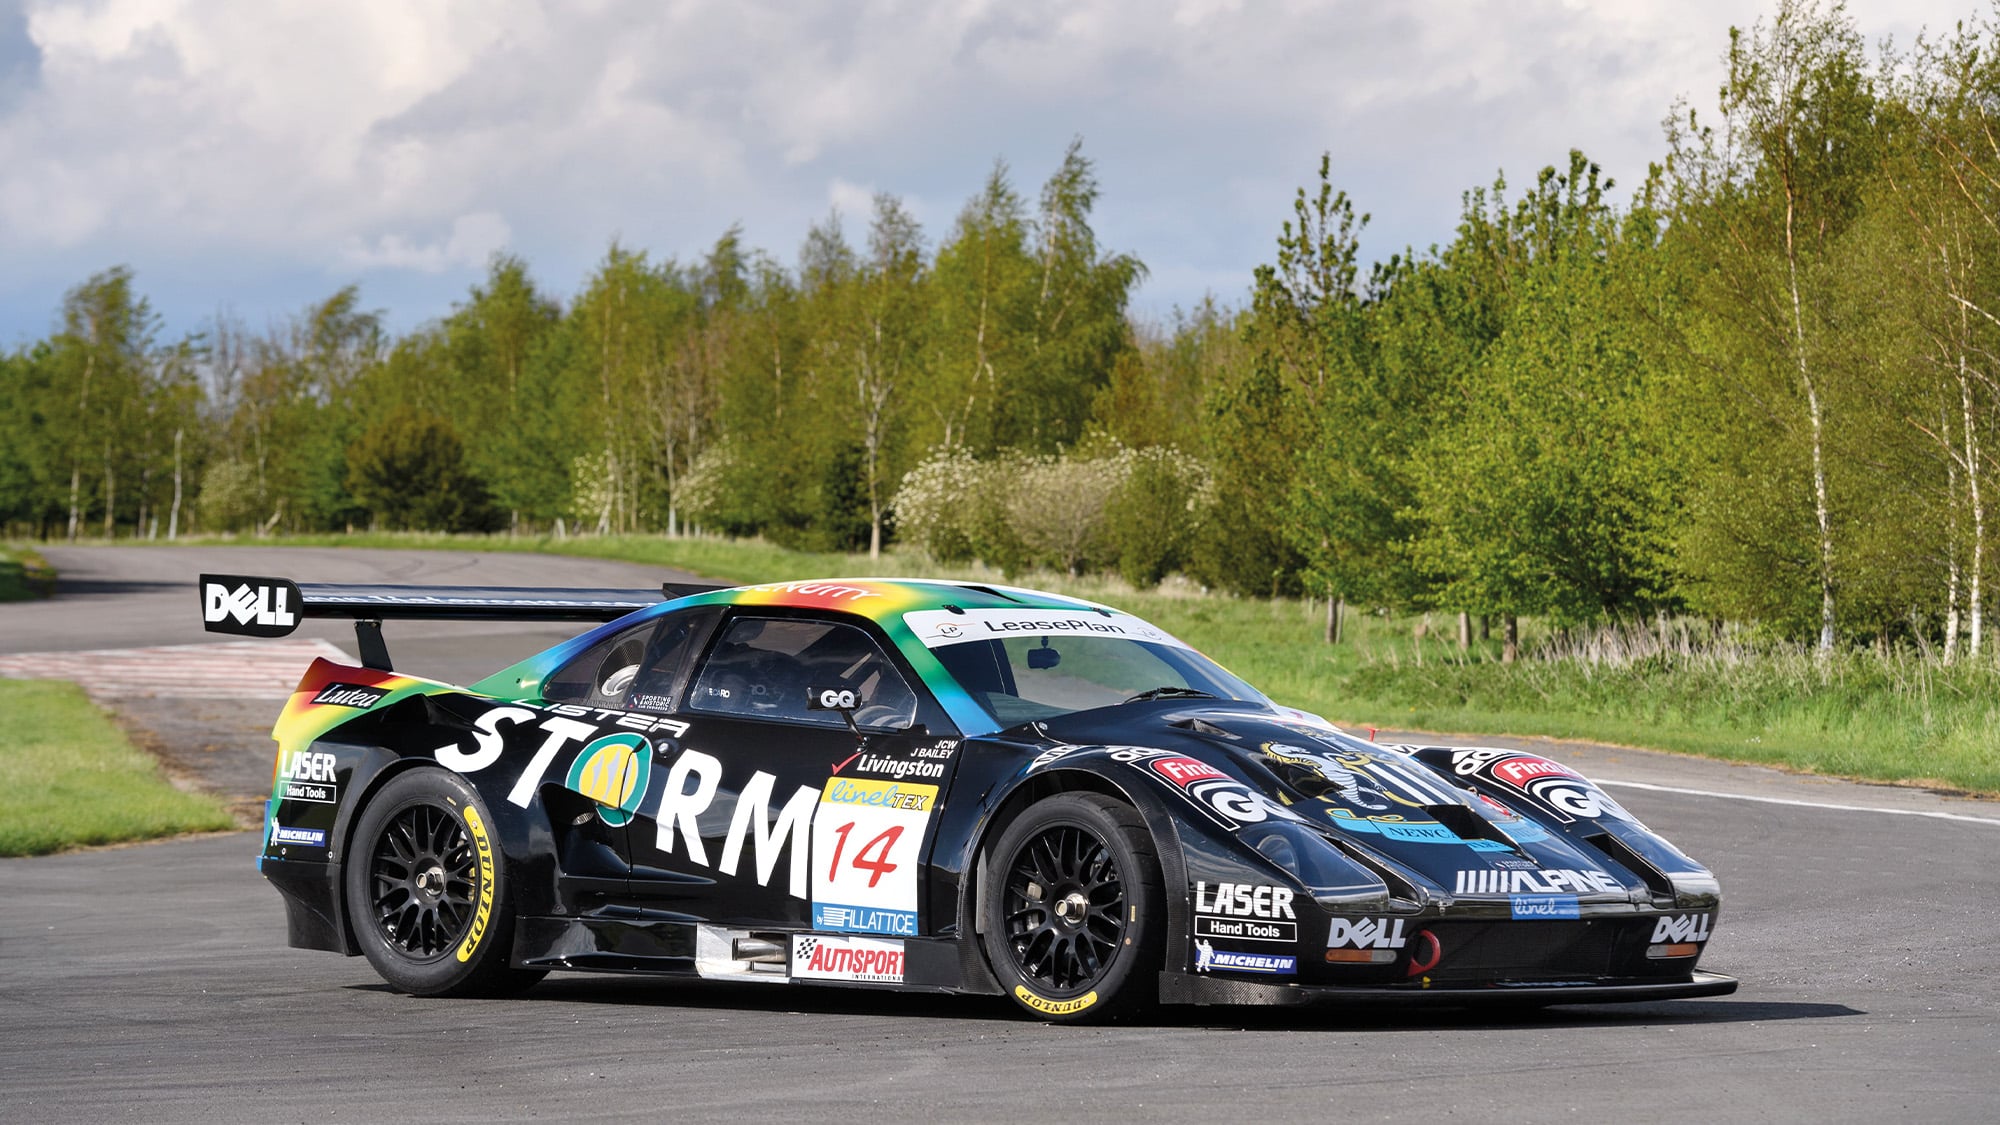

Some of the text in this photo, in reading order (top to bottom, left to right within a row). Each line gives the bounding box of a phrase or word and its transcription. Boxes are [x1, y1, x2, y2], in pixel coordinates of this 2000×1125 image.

[205, 583, 294, 626] DELL
[984, 620, 1126, 635] LeasePlan
[314, 684, 381, 708] Lutea
[820, 689, 856, 709] GQ
[511, 698, 691, 739] LISTER
[910, 748, 955, 760] J BAILEY
[934, 740, 959, 750] JCW
[280, 750, 337, 783] LASER
[857, 754, 945, 779] Livingston
[1161, 761, 1218, 779] Find
[286, 785, 326, 799] Hand Tools
[279, 830, 324, 842] MICHELIN
[829, 821, 905, 888] 14
[1510, 869, 1627, 893] ALPINE
[465, 835, 493, 954] DUNLOP
[1195, 881, 1296, 919] LASER
[1515, 897, 1557, 915] linel
[1210, 920, 1280, 938] Hand Tools
[1327, 916, 1408, 949] DELL
[1650, 913, 1709, 944] DELL
[1214, 953, 1294, 969] MICHELIN
[852, 974, 904, 982] INTERNATIONA
[1021, 994, 1082, 1013] DUNLOP
